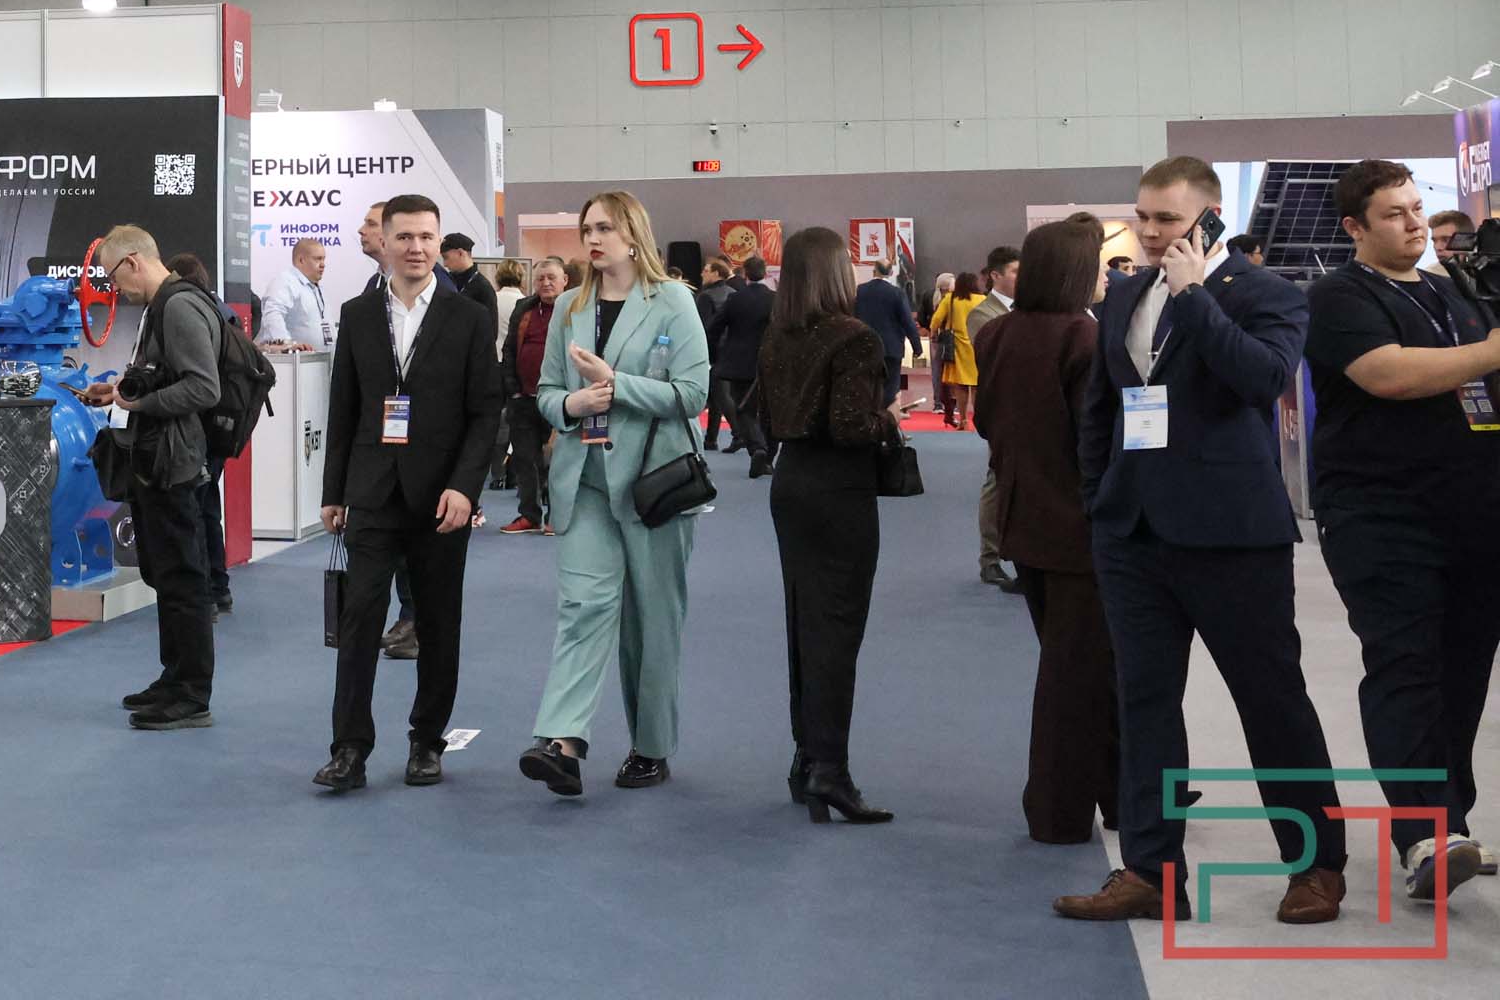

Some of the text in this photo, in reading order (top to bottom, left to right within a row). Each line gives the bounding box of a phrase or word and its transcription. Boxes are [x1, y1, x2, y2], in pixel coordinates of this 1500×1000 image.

[653, 28, 672, 72] 1
[252, 154, 330, 175] ЕРНЫЙ
[337, 156, 414, 178] ЦЕНТР
[53, 188, 96, 196] РОССИИ
[280, 223, 339, 233] ИНФОРМ
